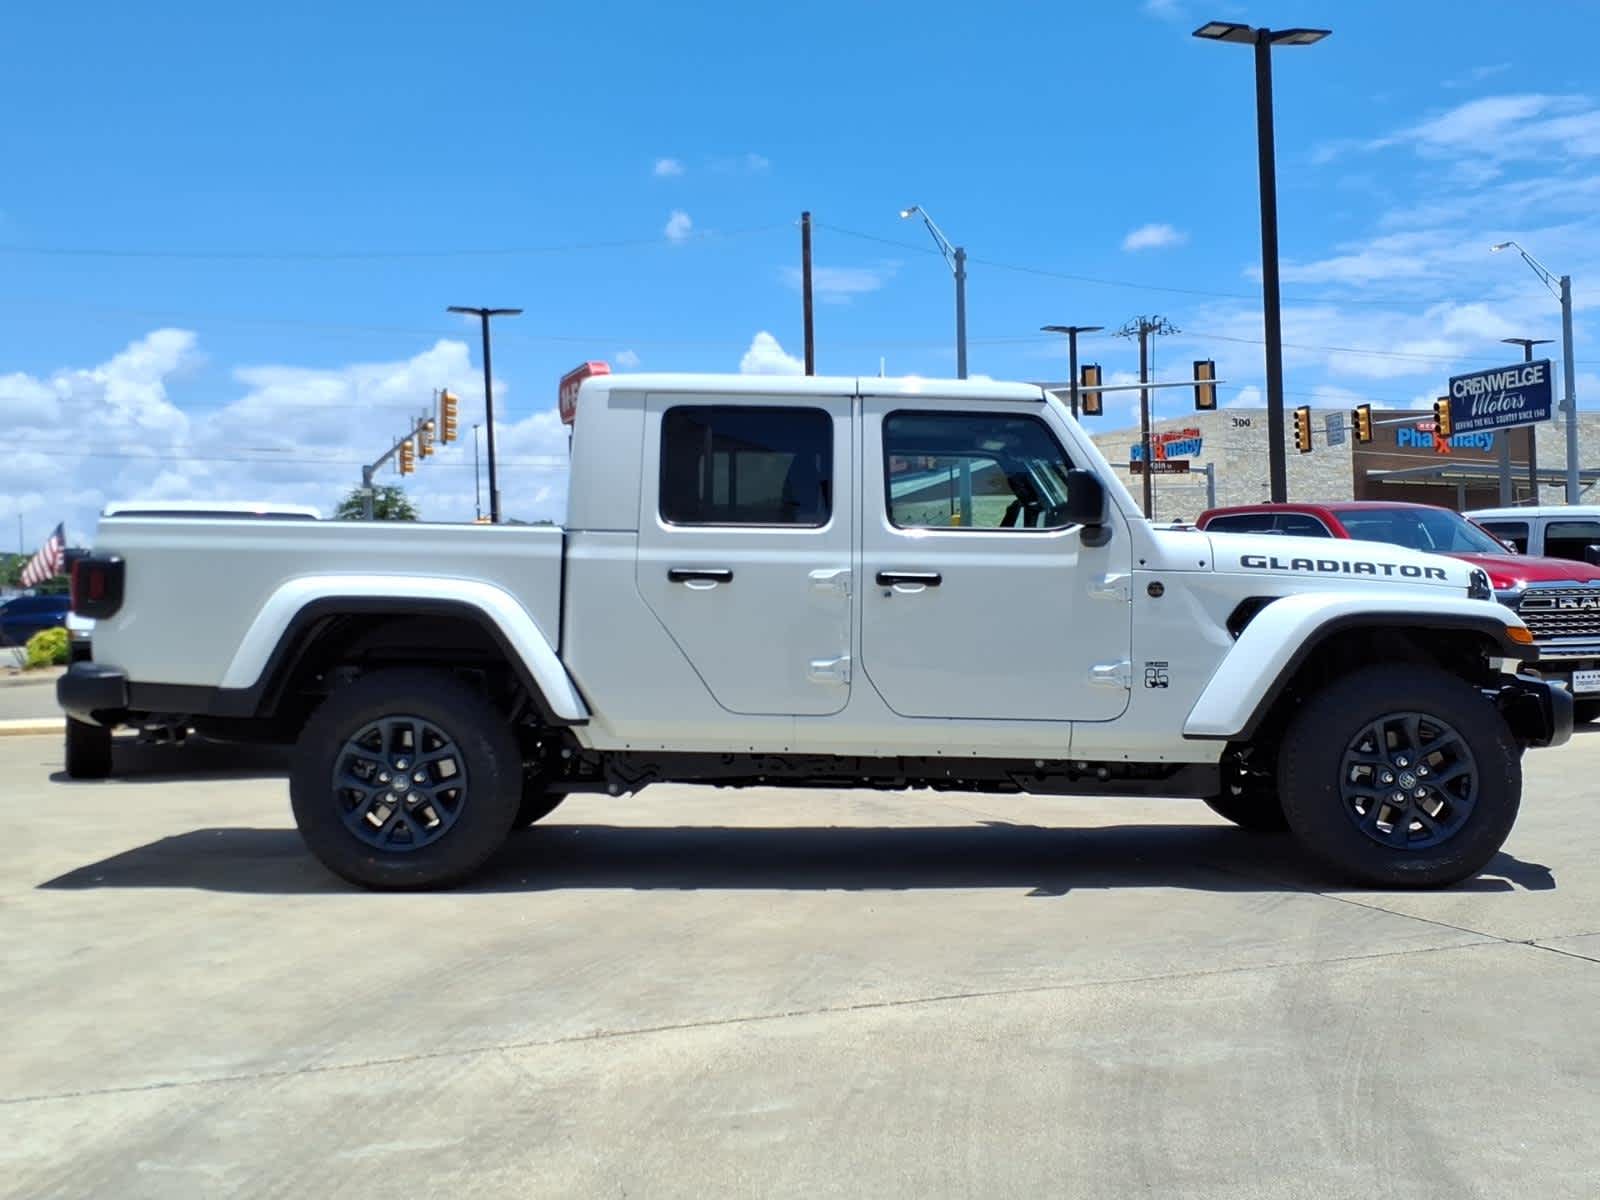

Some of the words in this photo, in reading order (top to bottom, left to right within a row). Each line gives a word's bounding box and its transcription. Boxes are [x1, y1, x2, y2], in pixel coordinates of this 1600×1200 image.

[1453, 365, 1544, 397] CRENWELGE
[1471, 391, 1526, 416] Motors
[1232, 418, 1250, 427] 300
[1240, 555, 1448, 581] GLADIATOR
[1559, 597, 1600, 609] RA
